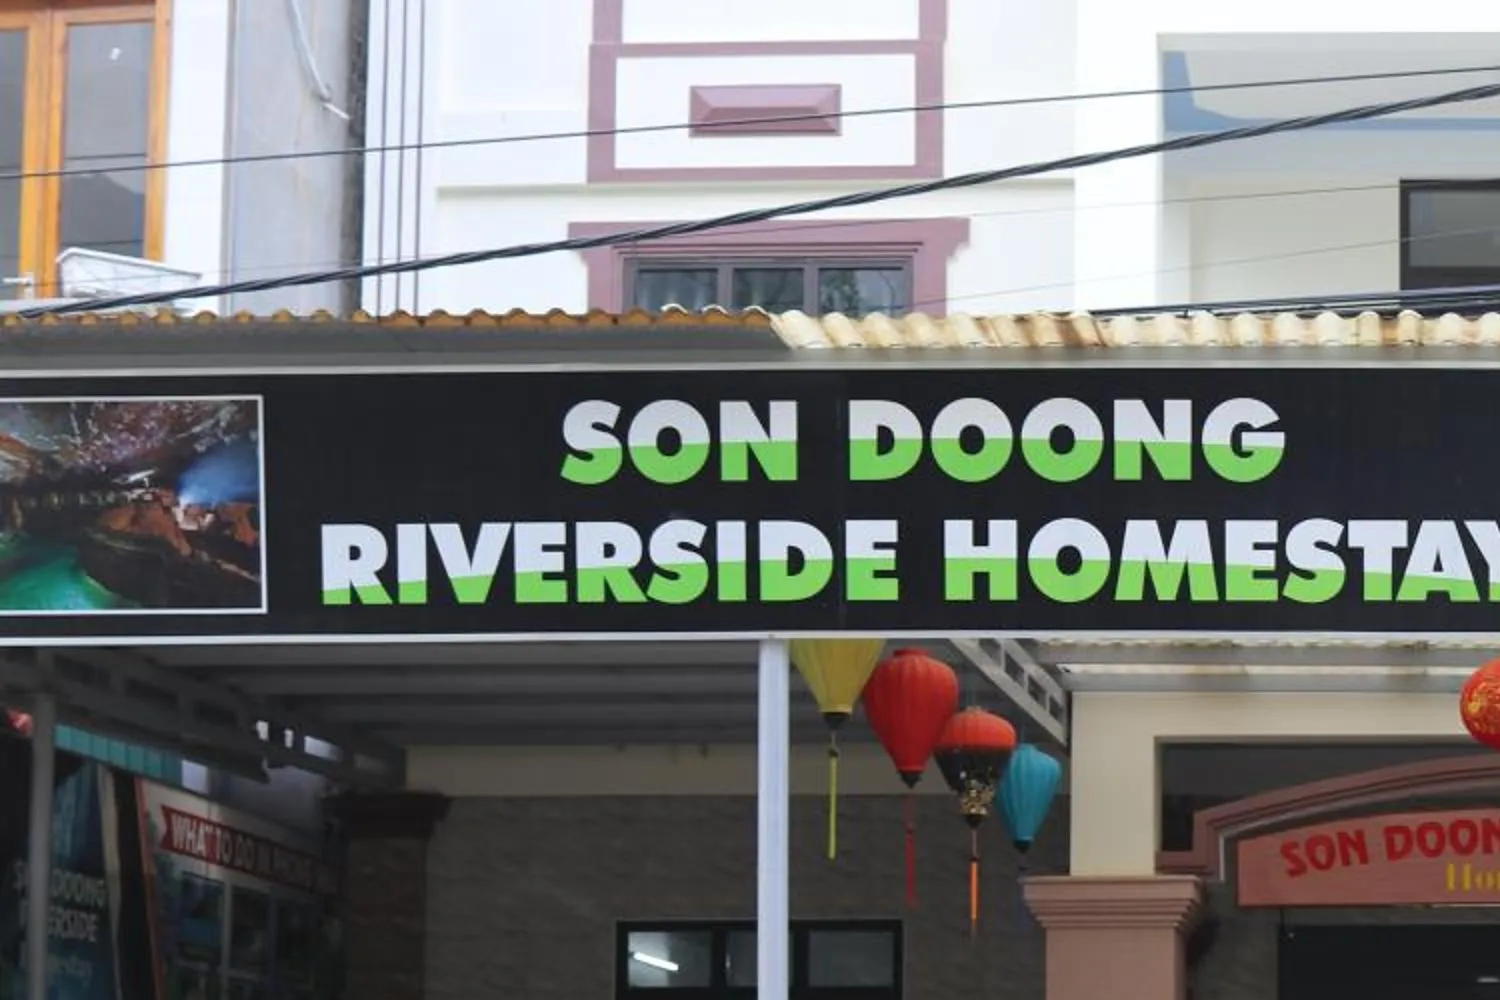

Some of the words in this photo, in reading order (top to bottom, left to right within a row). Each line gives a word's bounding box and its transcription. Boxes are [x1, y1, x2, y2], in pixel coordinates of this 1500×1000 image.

[562, 399, 799, 486] SON
[849, 397, 1287, 485] DOONG
[321, 519, 900, 606] RIVERSIDE
[1279, 832, 1369, 878] SON
